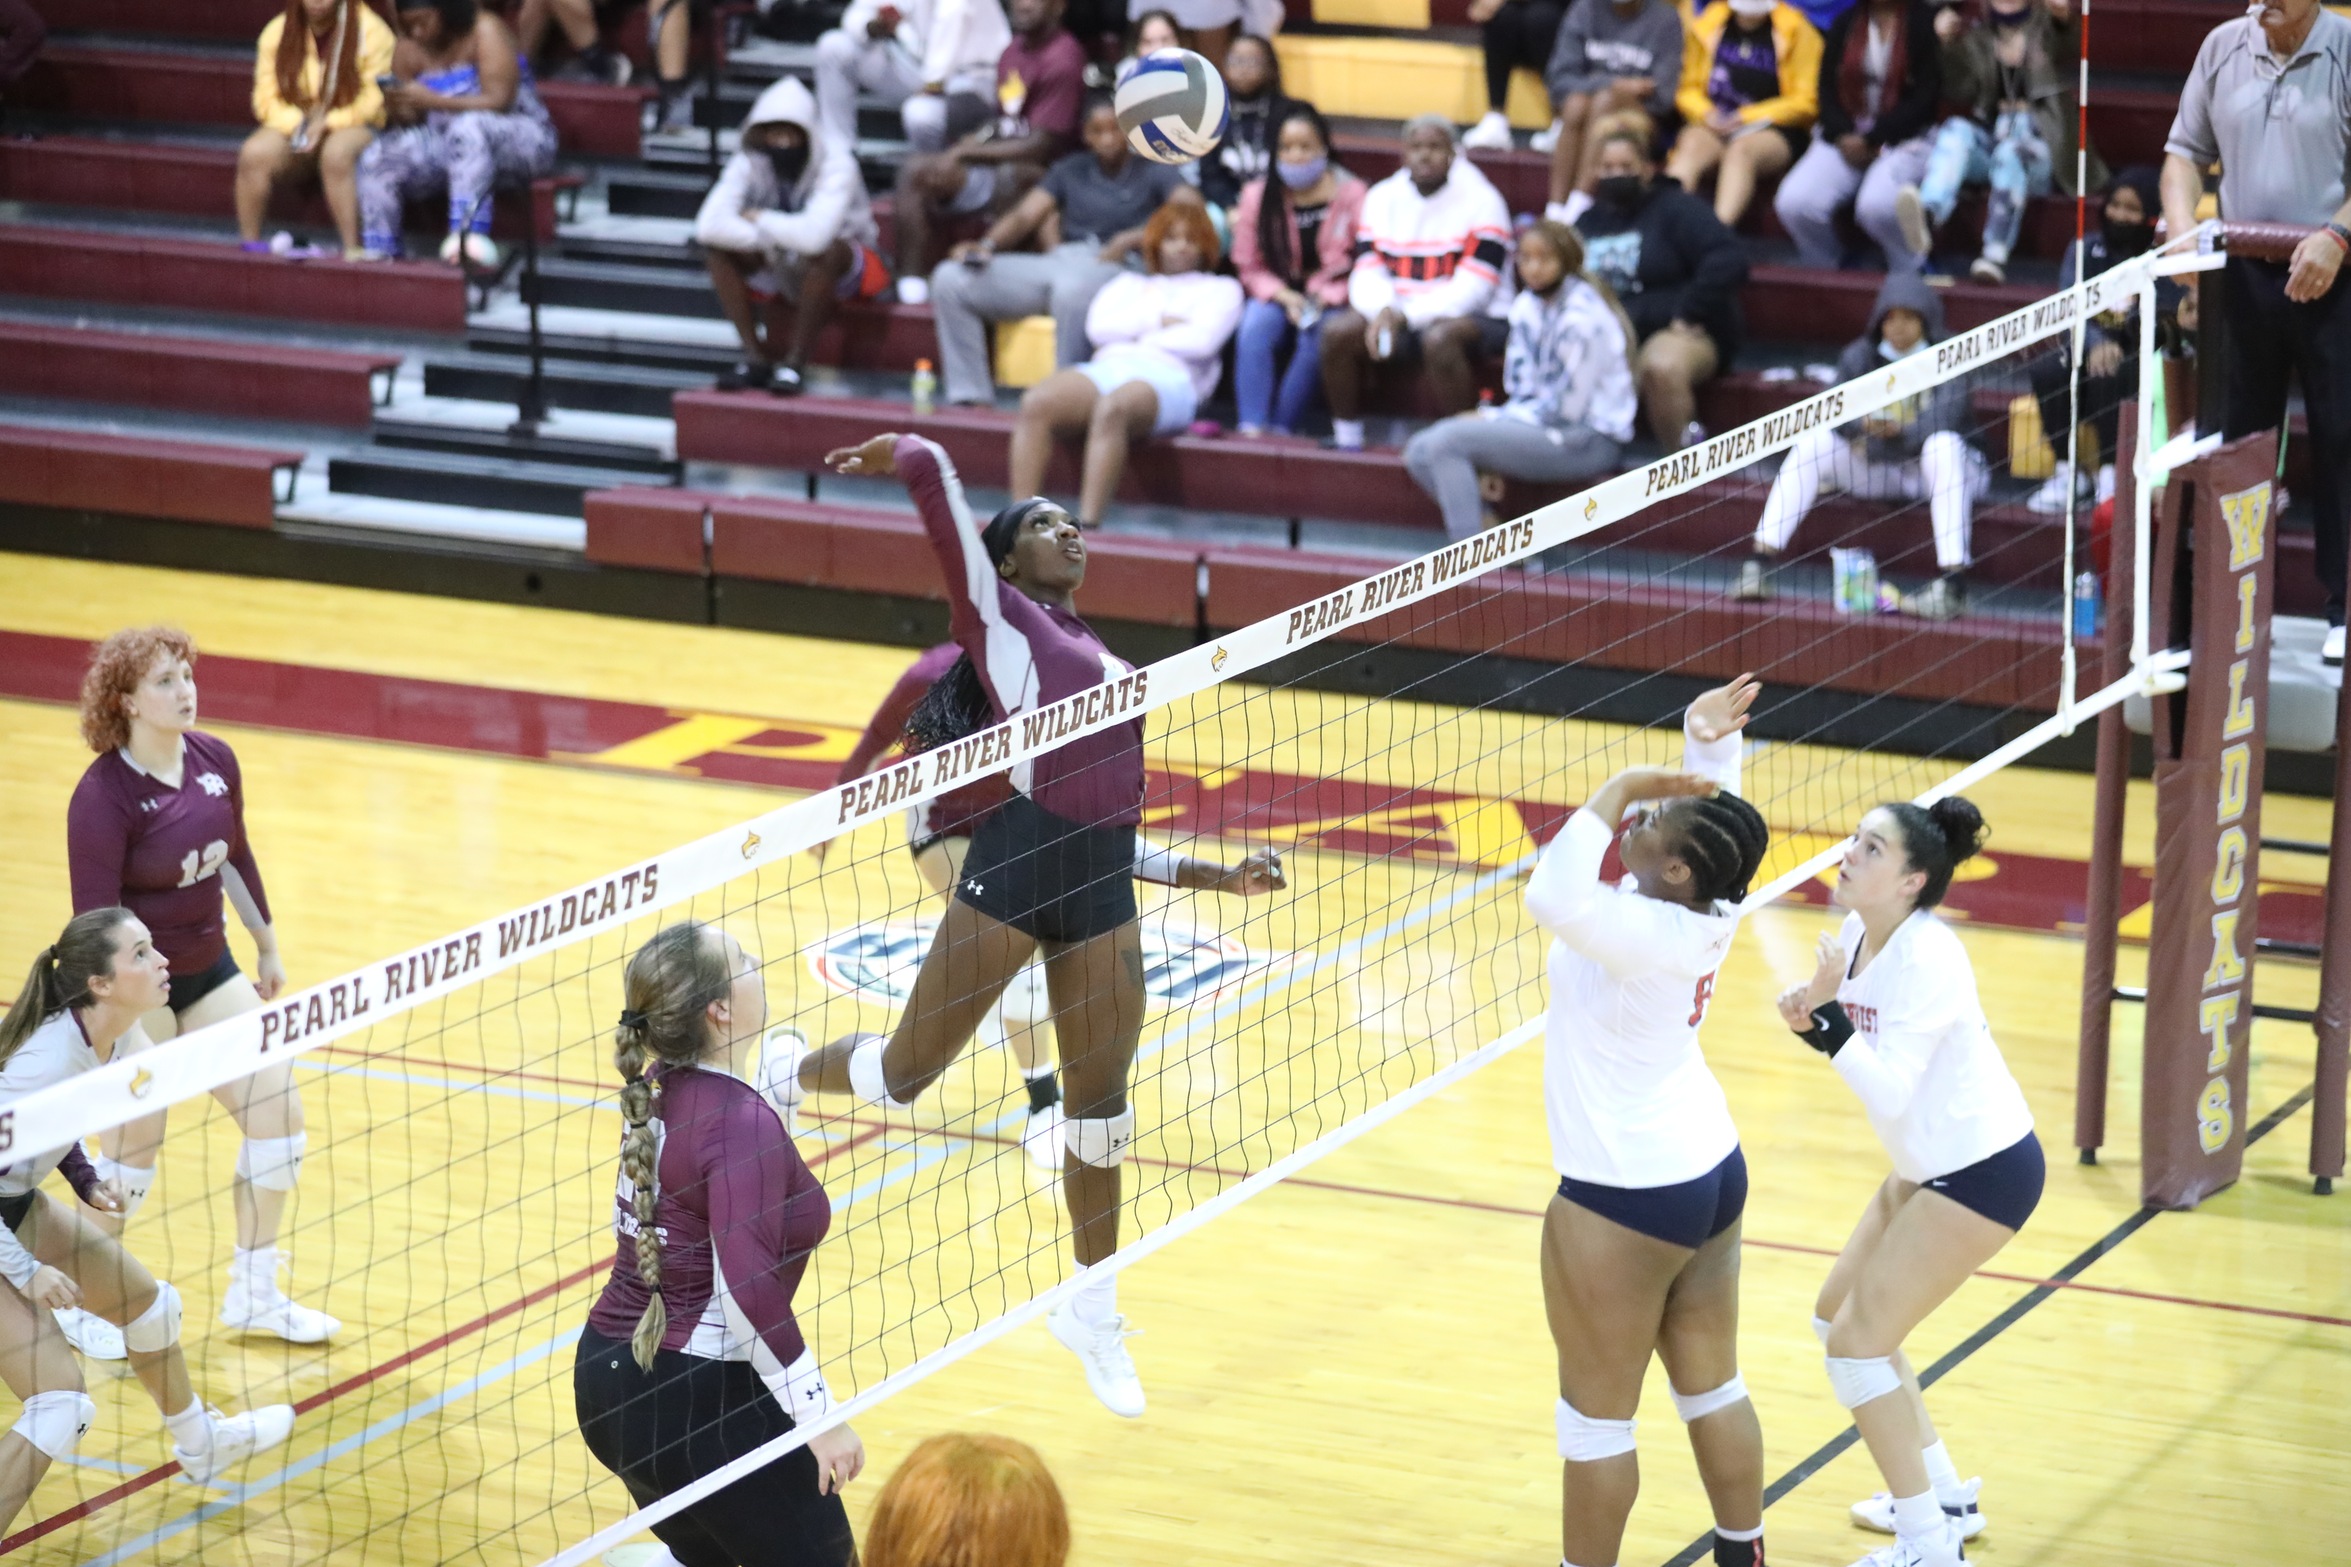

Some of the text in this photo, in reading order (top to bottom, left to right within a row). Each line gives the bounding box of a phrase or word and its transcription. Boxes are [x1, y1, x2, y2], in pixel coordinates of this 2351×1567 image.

[1937, 282, 2101, 374] PEARL RIVER WILDCTS
[1645, 390, 1845, 497] PEARL RIVER WILDCATS
[1286, 517, 1534, 645] PEARL RIVER WILDCATS
[838, 759, 924, 826] PEARL
[934, 724, 1013, 788] RIVER
[1022, 670, 1149, 752] WILDCATS
[177, 838, 229, 888] 12
[2198, 480, 2273, 1157] WILDCATS
[261, 863, 660, 1054] PEARL RIVER WILDCATS
